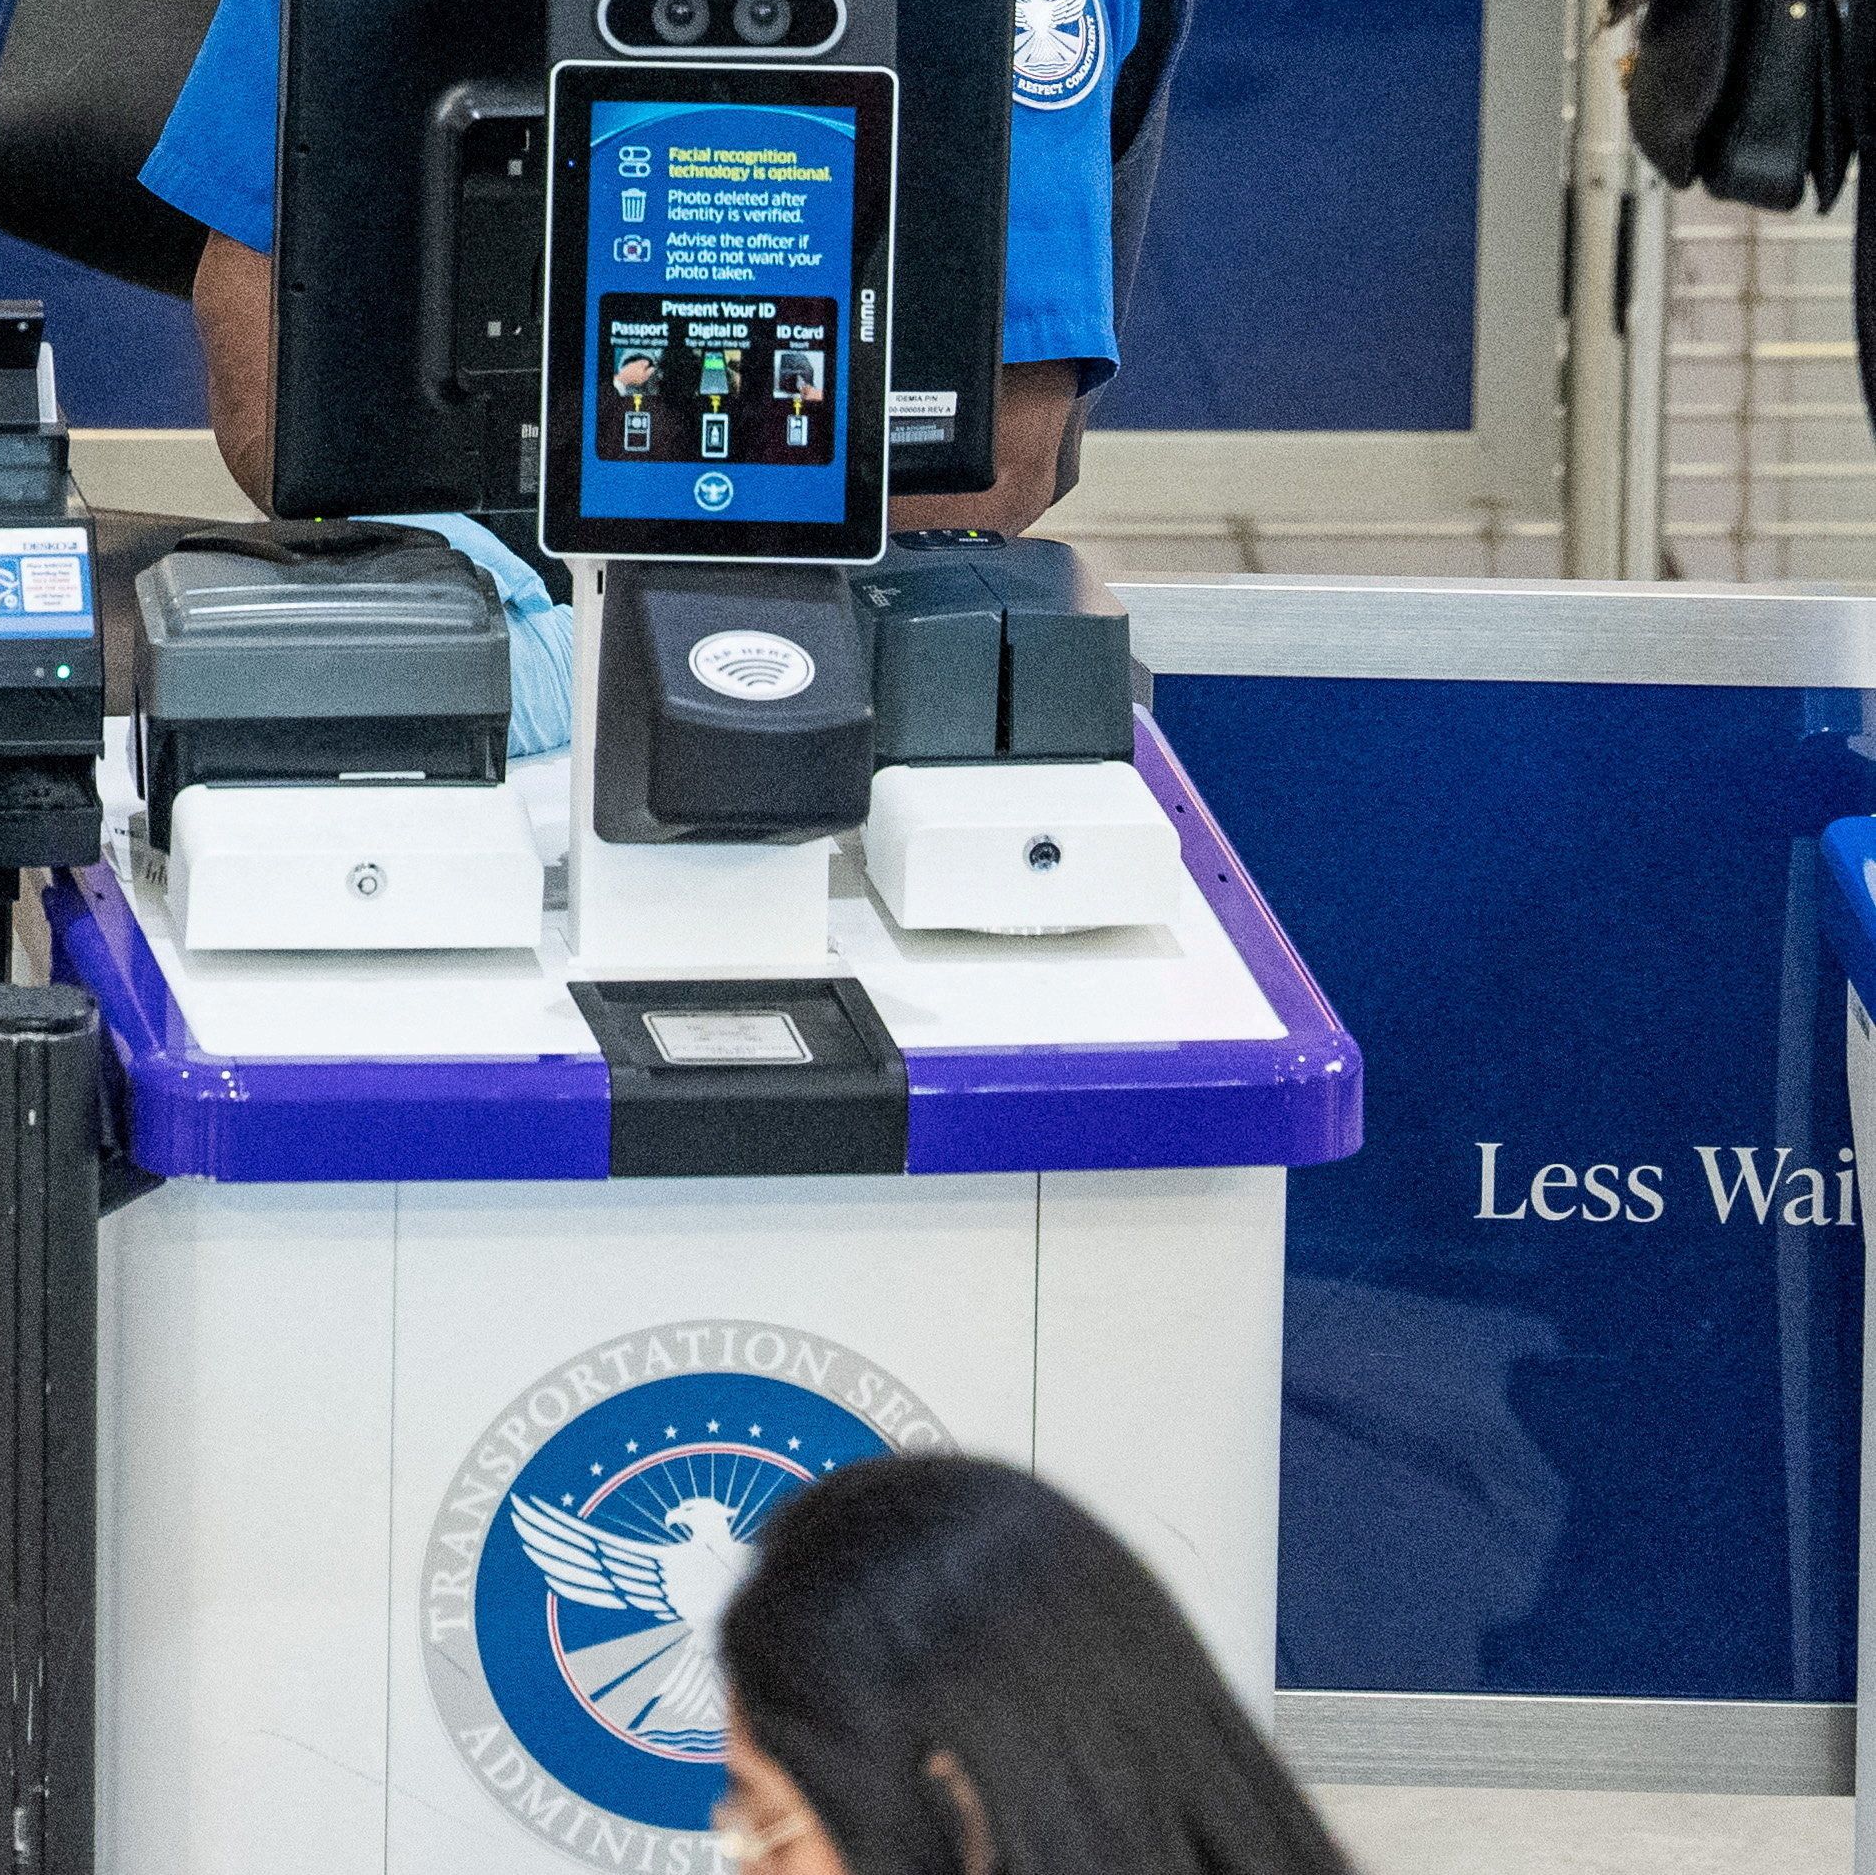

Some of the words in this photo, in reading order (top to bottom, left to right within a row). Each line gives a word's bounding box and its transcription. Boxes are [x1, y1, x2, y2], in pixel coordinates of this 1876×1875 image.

[1018, 78, 1064, 96] RESPECT
[669, 147, 709, 164] Facial
[712, 148, 796, 167] recognition
[668, 165, 750, 182] technology
[753, 166, 766, 179] is
[768, 165, 833, 182] optional.
[668, 189, 711, 207] Photo
[714, 191, 769, 207] deleted
[773, 192, 807, 207] after
[668, 205, 725, 223] identity
[728, 207, 740, 222] is
[743, 206, 803, 223] verified.
[666, 232, 716, 250] Advise
[719, 234, 744, 249] the
[747, 232, 795, 250] officer
[798, 233, 809, 249] if
[666, 251, 694, 266] you
[697, 250, 715, 264] do
[718, 251, 744, 265] not
[747, 252, 784, 266] want
[788, 253, 822, 267] your
[665, 264, 708, 282] photo
[712, 266, 755, 282] taken.
[662, 301, 718, 317] Present
[722, 302, 756, 318] Your
[758, 303, 776, 318] ID
[860, 289, 875, 342] mimo
[611, 322, 669, 338] Passport
[688, 323, 730, 339] Digital
[732, 324, 748, 338] ID
[776, 325, 791, 339] ID
[793, 325, 824, 339] Card
[1472, 1141, 1665, 1224] Less
[1692, 1146, 1857, 1226] Wai
[429, 1326, 837, 1642] TRANSPORTATION
